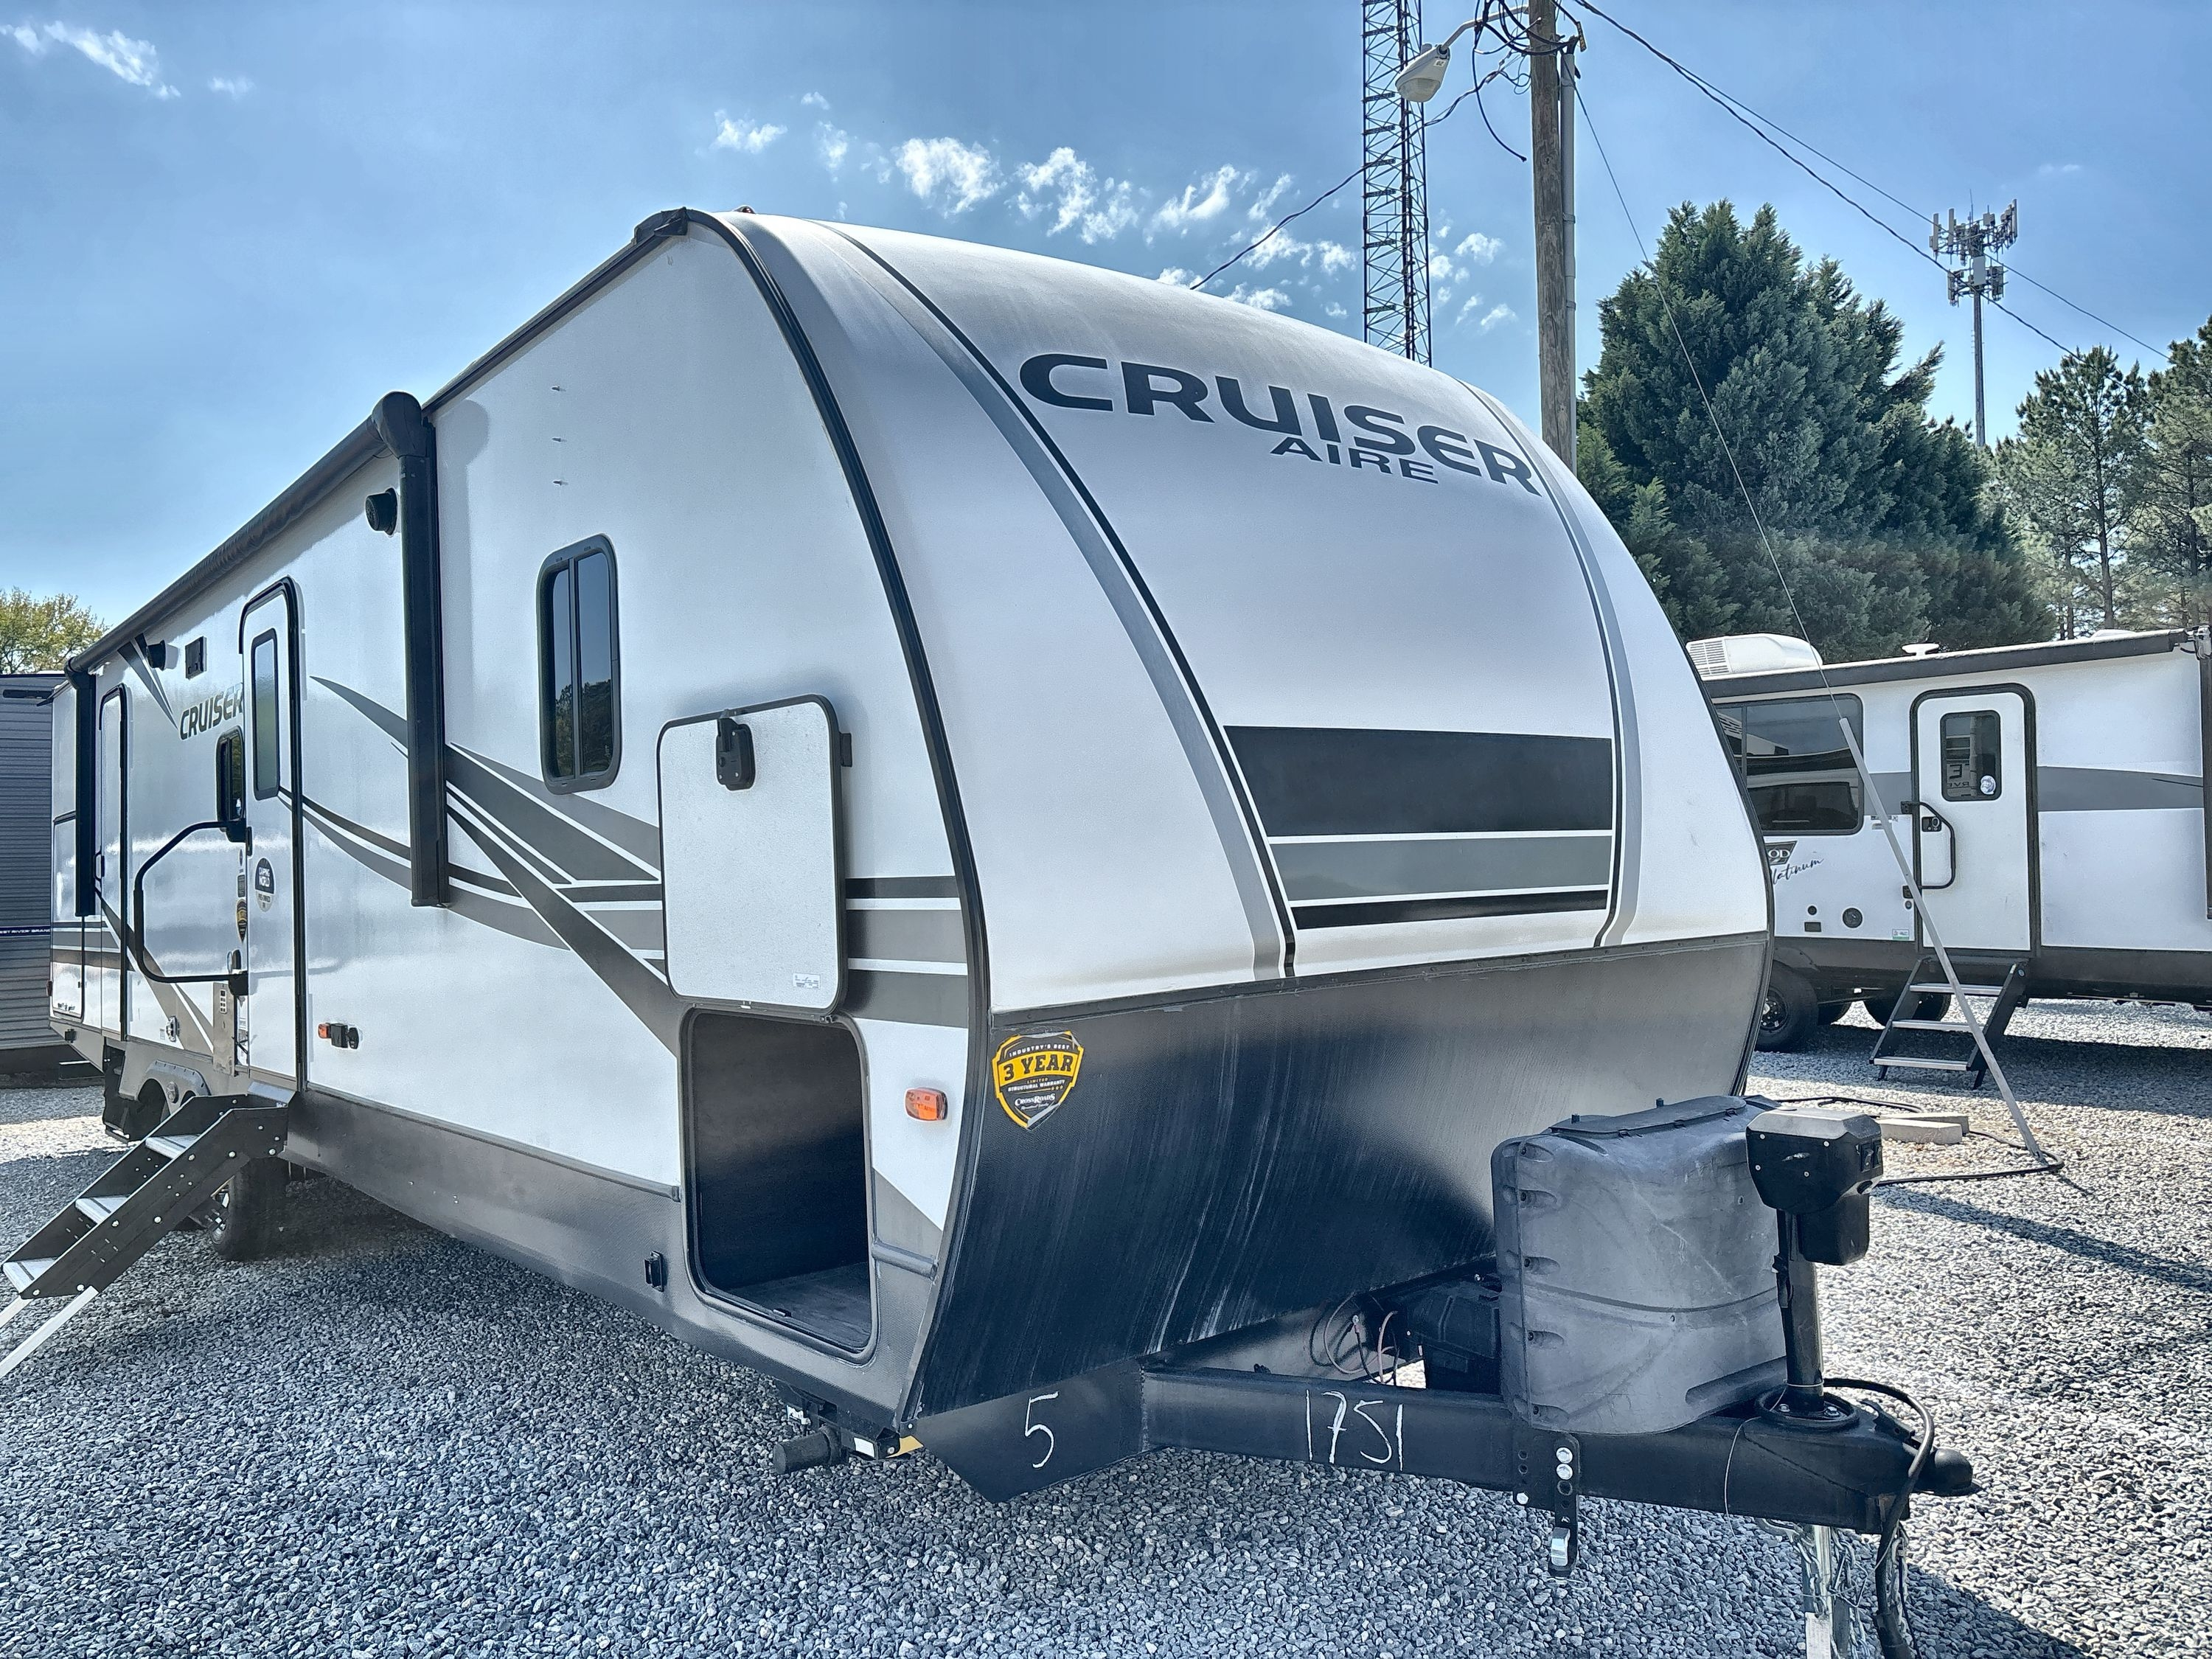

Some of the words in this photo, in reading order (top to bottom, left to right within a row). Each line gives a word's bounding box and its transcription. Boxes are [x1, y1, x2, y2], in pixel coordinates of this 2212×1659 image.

[1019, 353, 1543, 498] CRUISER
[1270, 437, 1439, 484] AIRE
[179, 683, 243, 740] CRUISER
[1770, 858, 1824, 885] latinum
[1004, 1062, 1015, 1081] 3
[1021, 1054, 1074, 1075] YEAR
[1009, 1044, 1051, 1057] INDUSTRY'S
[1008, 1083, 1039, 1091] STRUCTURAL
[1040, 1079, 1065, 1088] WARRANTY
[1023, 1391, 1059, 1467] 5
[1304, 1388, 1404, 1471] 1751
